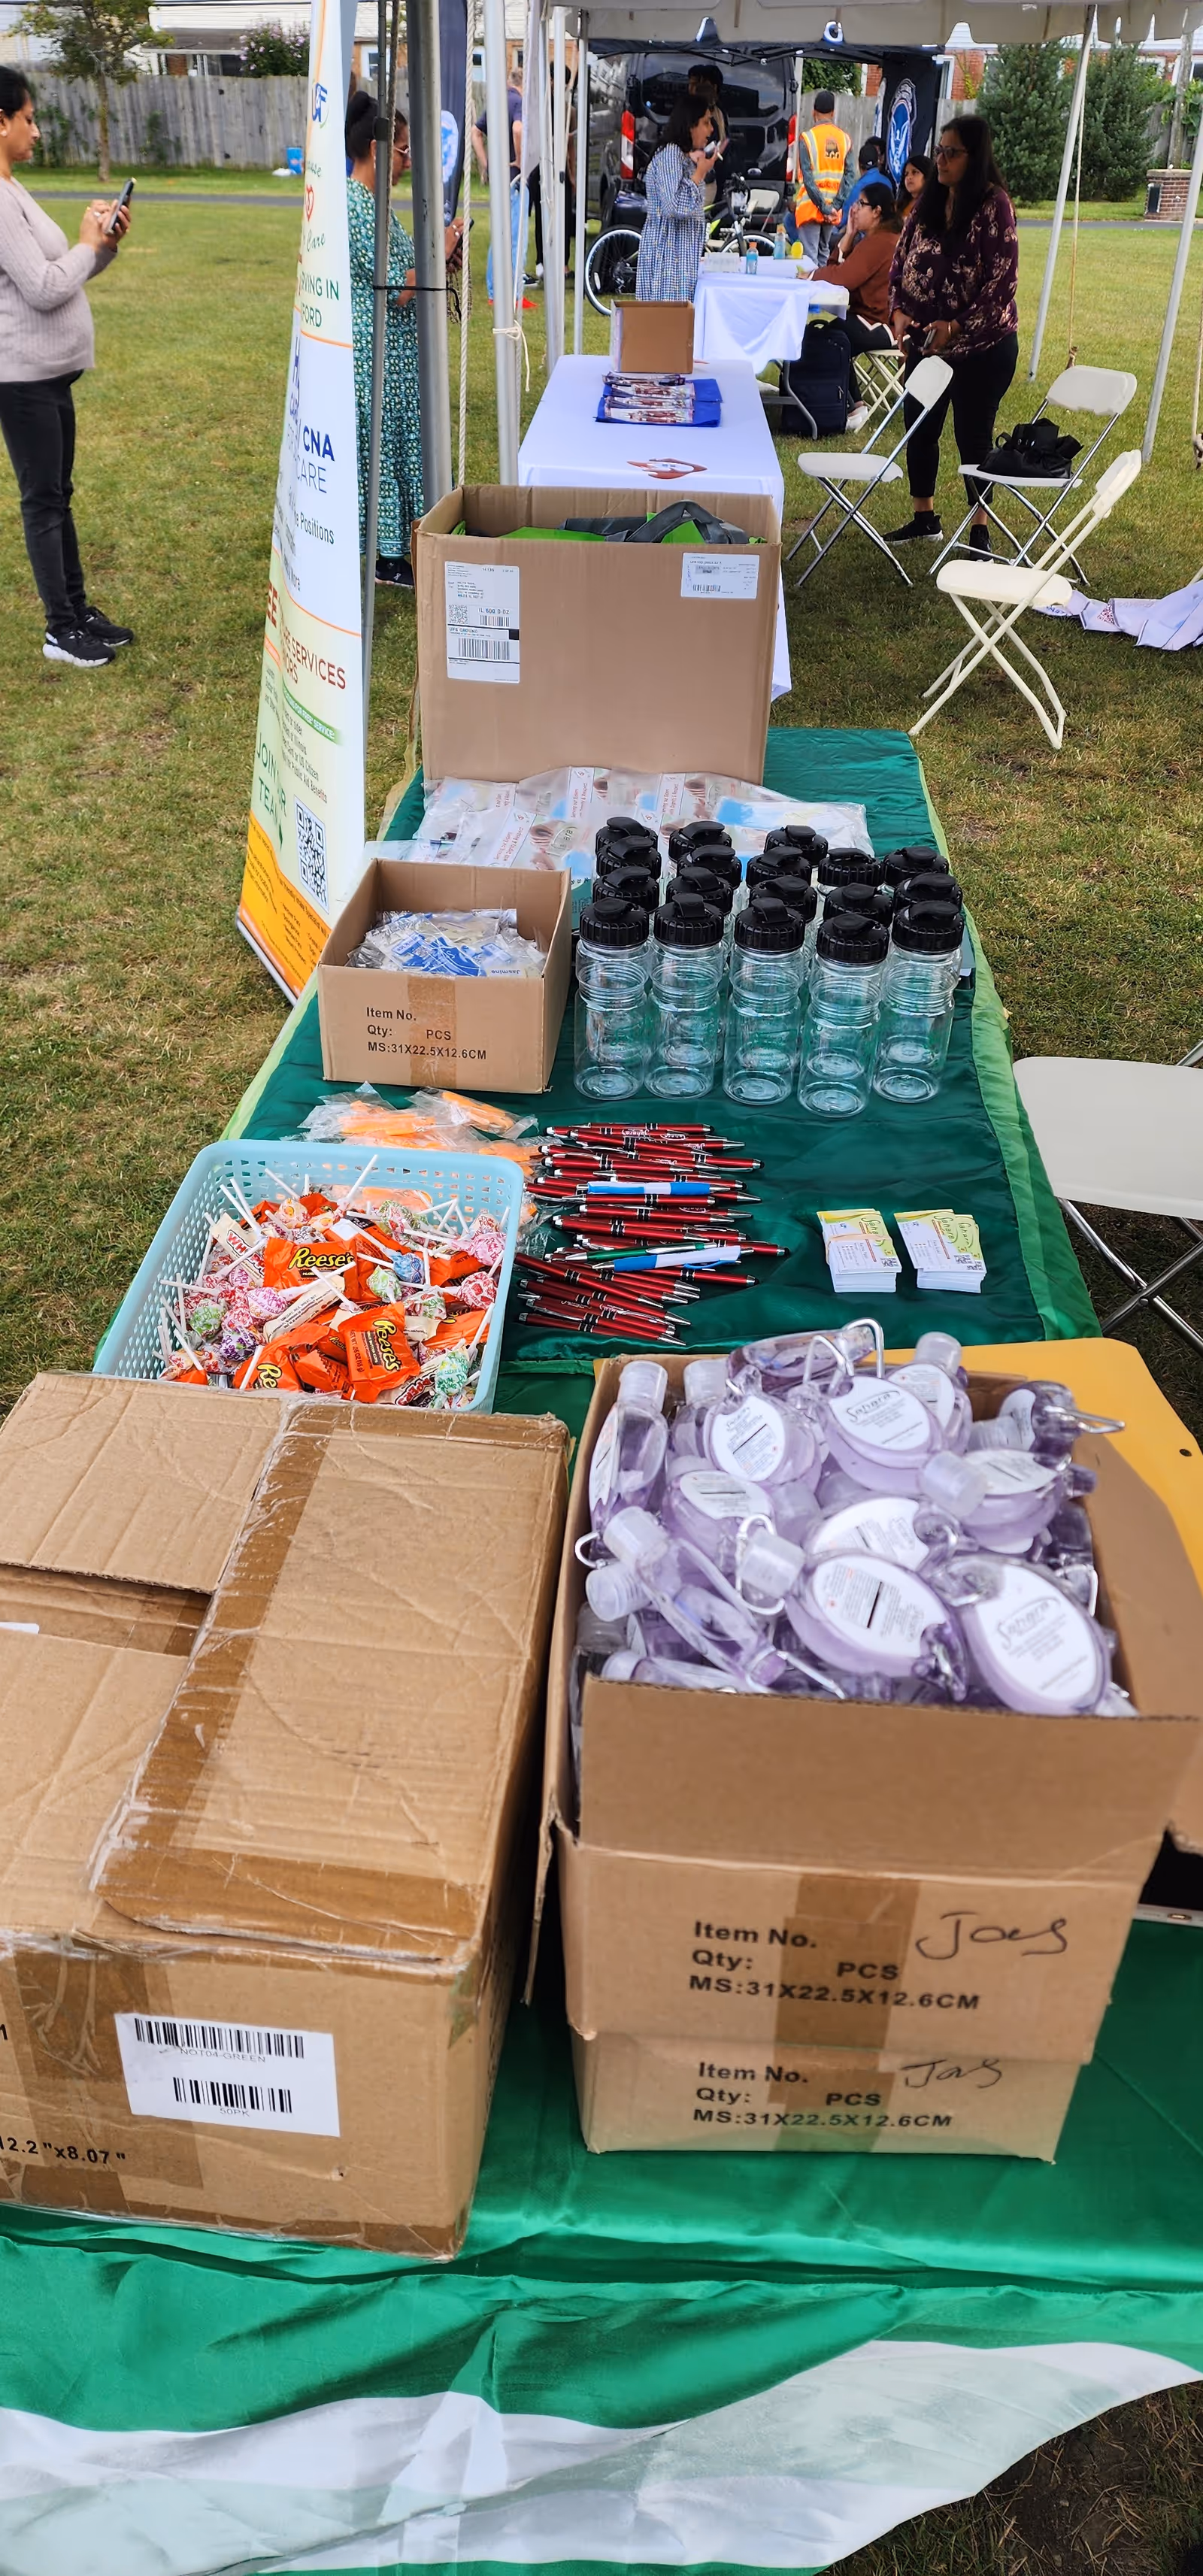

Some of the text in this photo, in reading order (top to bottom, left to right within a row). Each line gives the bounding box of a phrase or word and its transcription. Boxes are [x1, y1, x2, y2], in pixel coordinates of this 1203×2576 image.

[326, 277, 339, 301] IN
[301, 302, 323, 327] FORD
[303, 426, 335, 462] CNA
[300, 512, 335, 544] Positions
[292, 637, 346, 689] SERVICES
[366, 1006, 417, 1022] Item No.
[367, 1024, 452, 1041] Qty: PCS
[368, 1041, 486, 1060] MS:31X22.5X12.6CM
[287, 1247, 355, 1270] Reese's
[373, 1319, 402, 1371] Reese's
[256, 1363, 283, 1389] Re
[693, 1920, 817, 1949] Item No.
[692, 1949, 899, 1981] Qty: PCS
[689, 1974, 981, 2010] MS:31X22.5X12.6CM
[180, 2047, 266, 2063] NOT04-GREEN
[698, 2062, 809, 2085] Item No.
[696, 2087, 882, 2107] Qty: PCS
[220, 2107, 250, 2117] 50PK
[692, 2108, 953, 2129] MS:31X22.5X12.6CM
